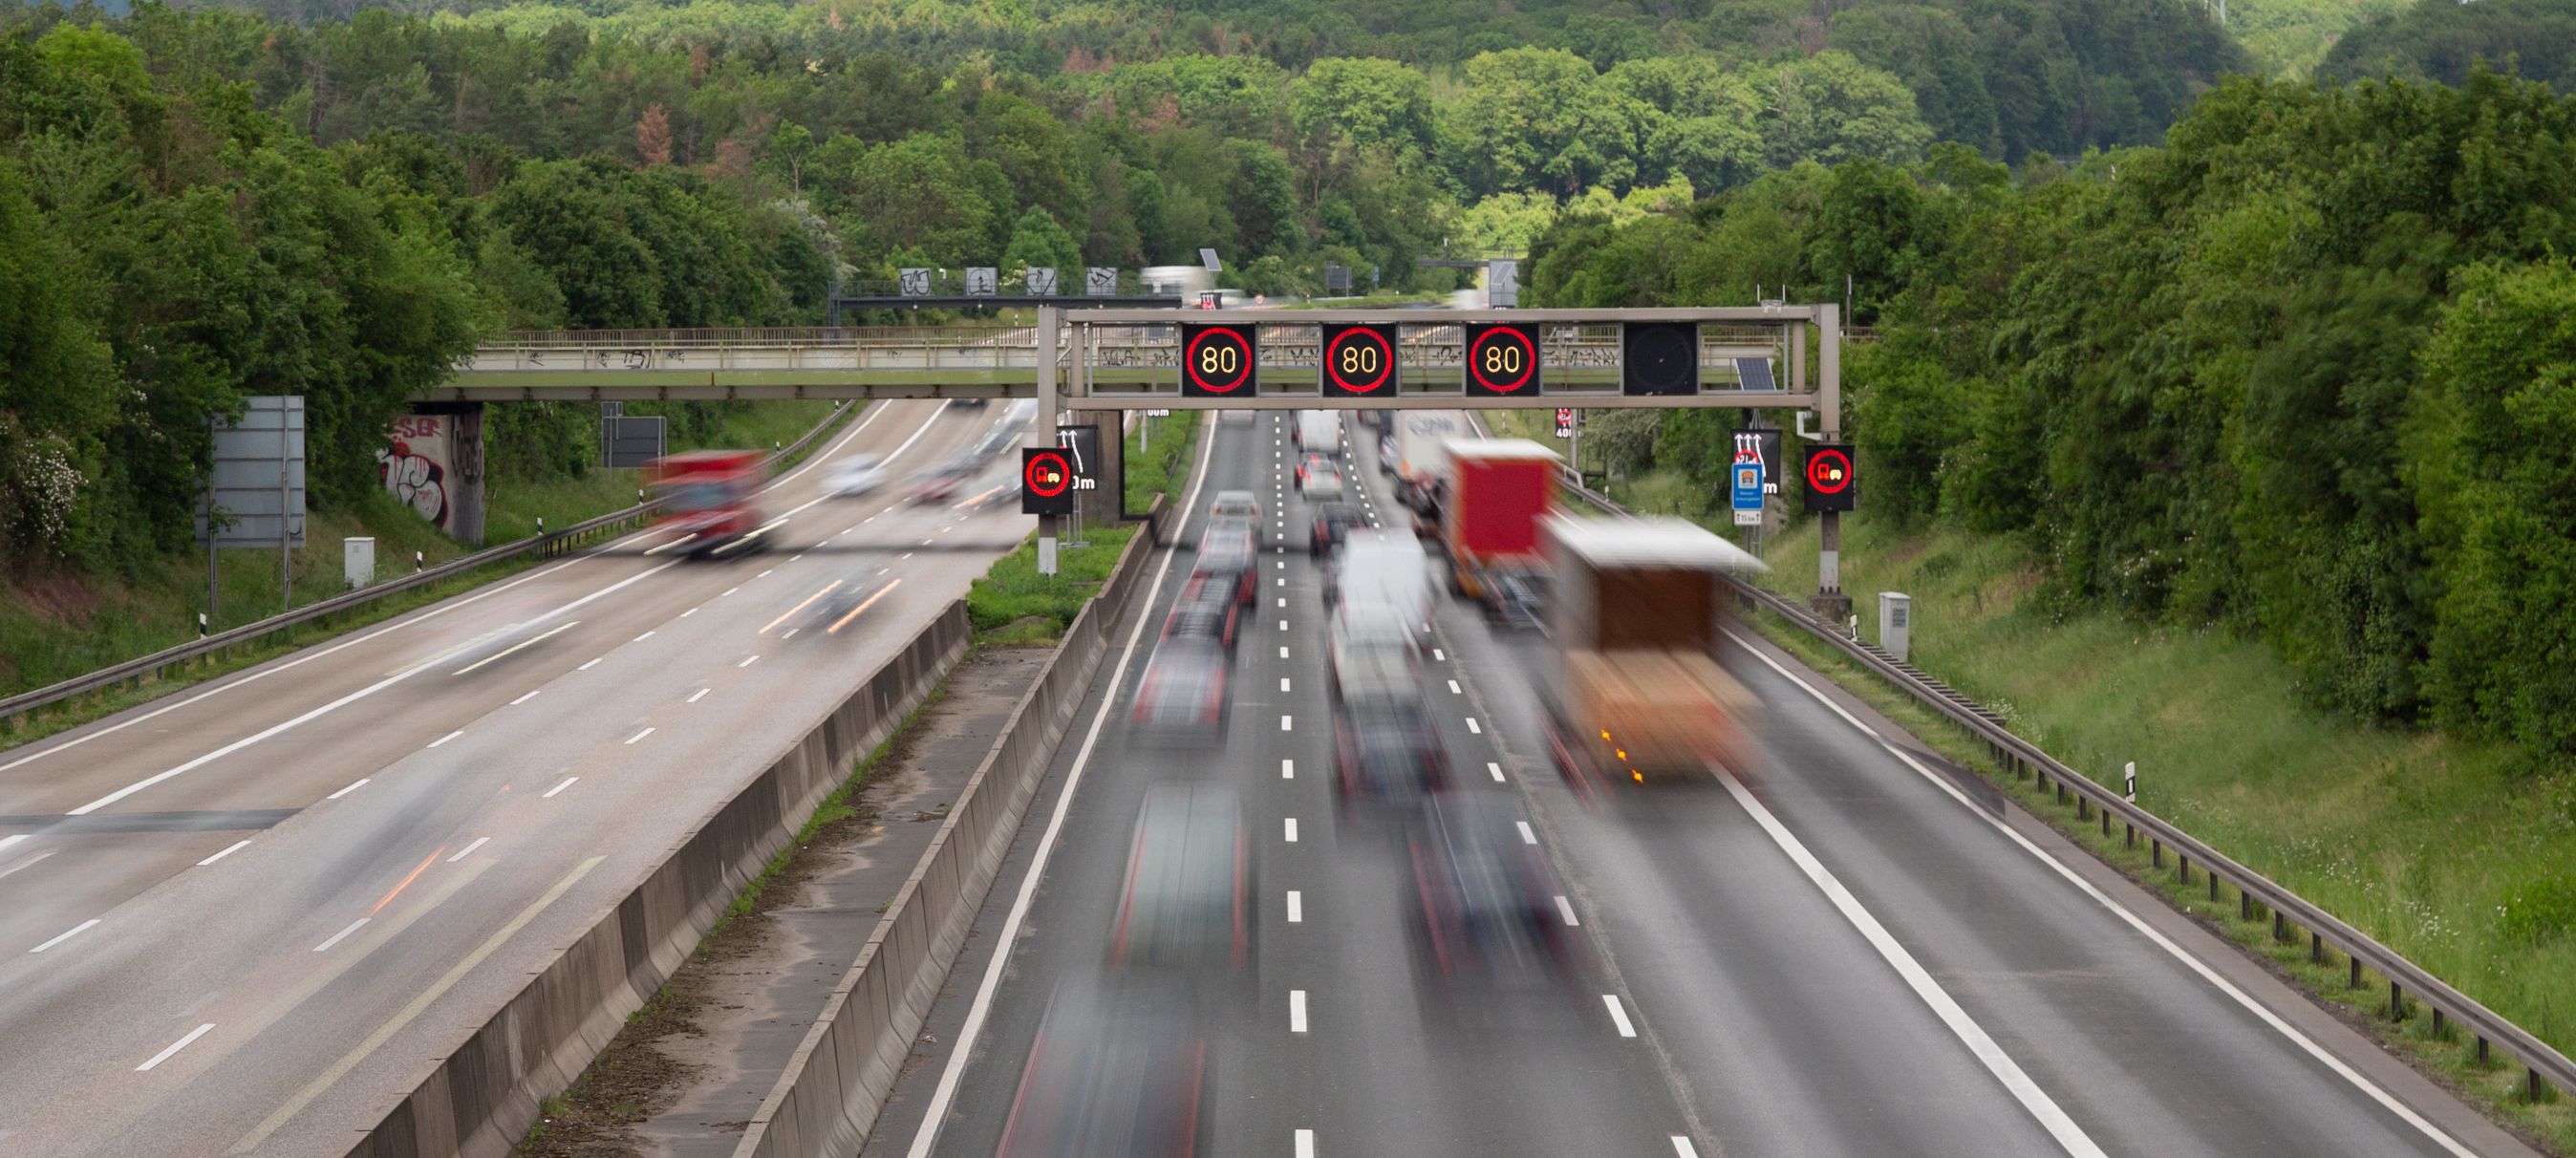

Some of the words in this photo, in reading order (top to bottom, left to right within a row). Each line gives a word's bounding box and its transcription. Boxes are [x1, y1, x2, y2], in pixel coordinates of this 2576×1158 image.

[1202, 346, 1236, 374] 80
[1342, 346, 1377, 374] 80
[1486, 346, 1520, 374] 80
